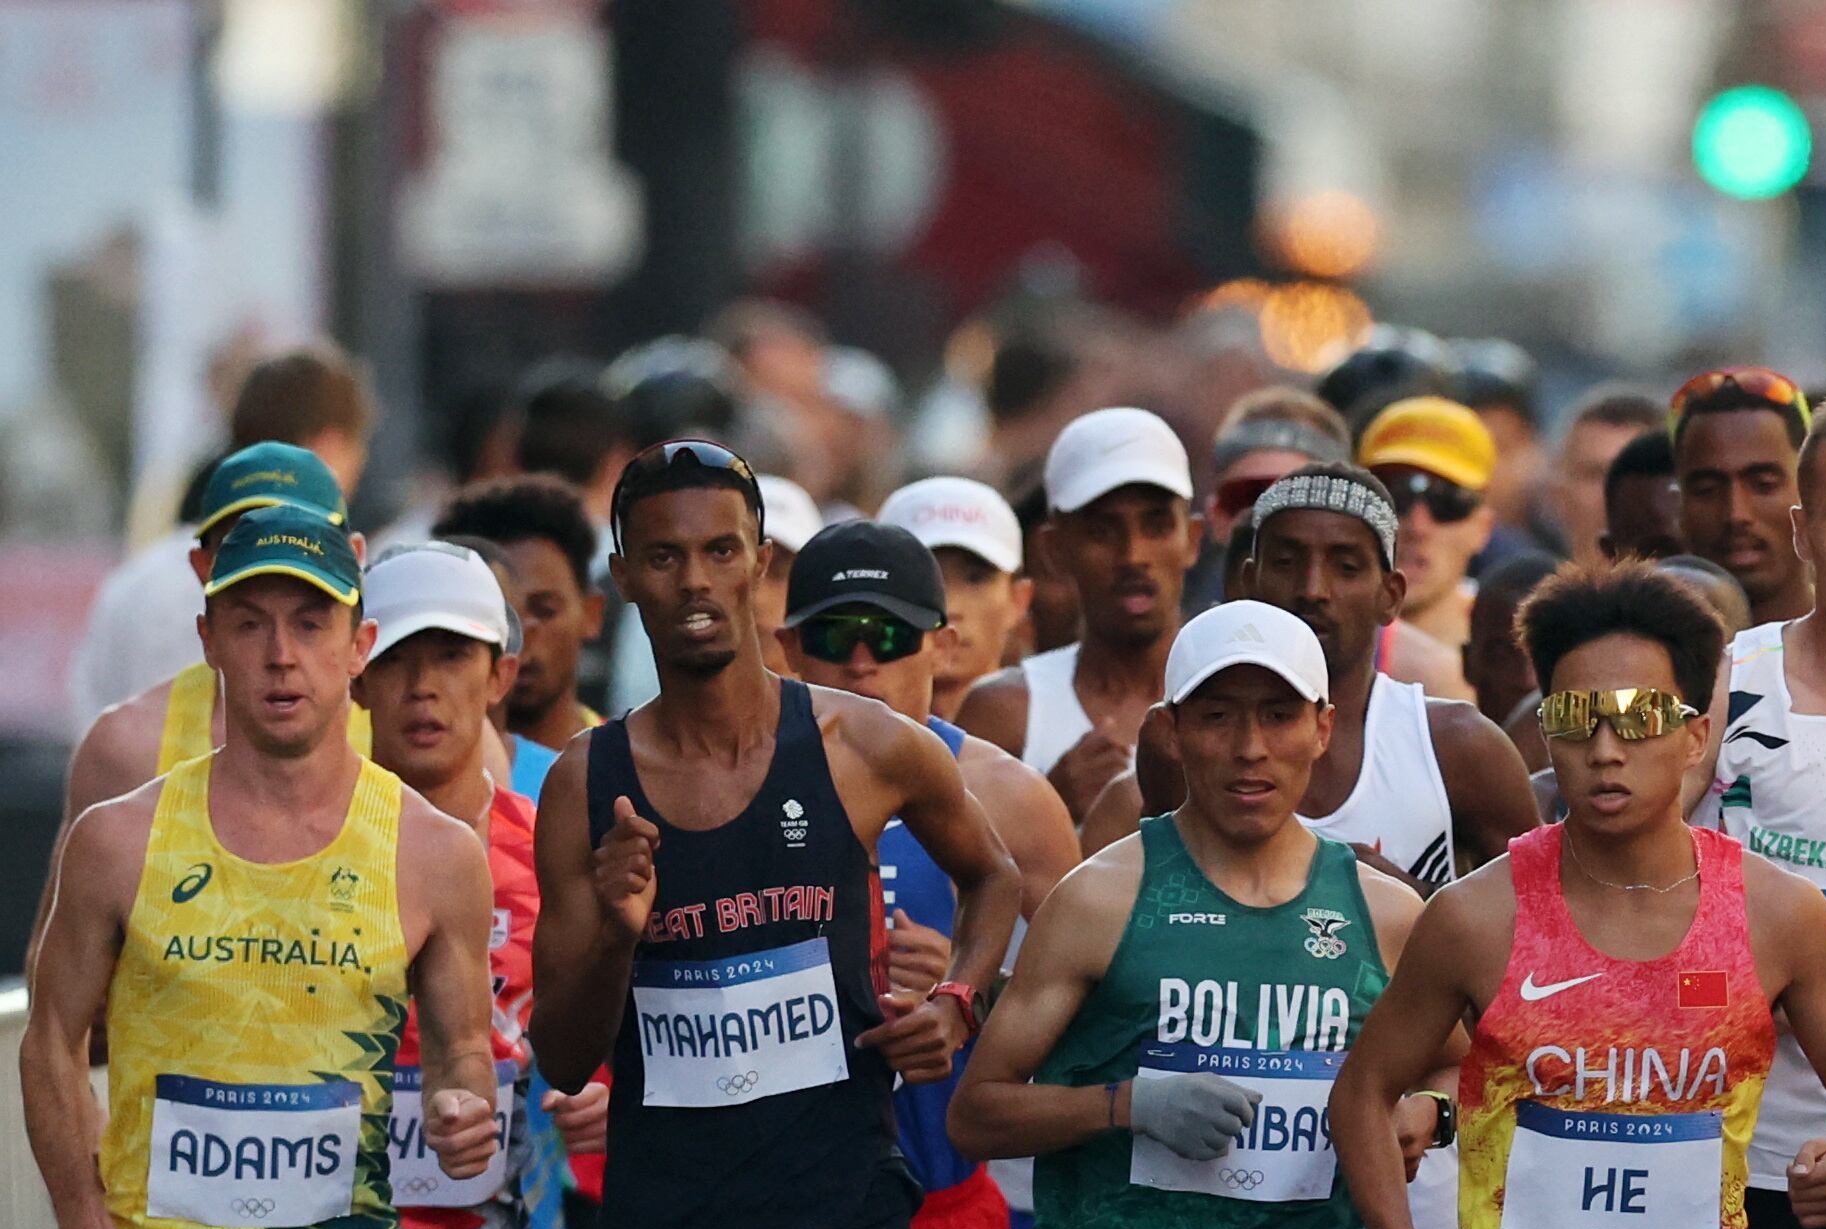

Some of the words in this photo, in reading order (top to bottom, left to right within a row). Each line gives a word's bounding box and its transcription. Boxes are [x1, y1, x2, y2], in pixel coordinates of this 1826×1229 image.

[256, 534, 324, 555] AUSTRALIA
[649, 903, 707, 942] EAT
[716, 886, 834, 933] BRITAIN
[1169, 913, 1226, 925] FORTE
[163, 935, 361, 969] AUSTRALIA
[673, 968, 720, 981] PARIS
[726, 959, 774, 980] 2024
[641, 993, 834, 1058] MAHAMED
[1157, 978, 1349, 1053] BOLIVIA
[1198, 1054, 1249, 1069] PARIS
[1258, 1057, 1303, 1071] 2024
[1526, 1045, 1728, 1102] CHINA
[205, 1087, 256, 1105] PARIS
[264, 1091, 310, 1105] 2024
[1565, 1119, 1618, 1134] PARIS
[1627, 1122, 1672, 1136] 2024
[169, 1129, 341, 1180] ADAMS
[1581, 1167, 1649, 1214] HE
